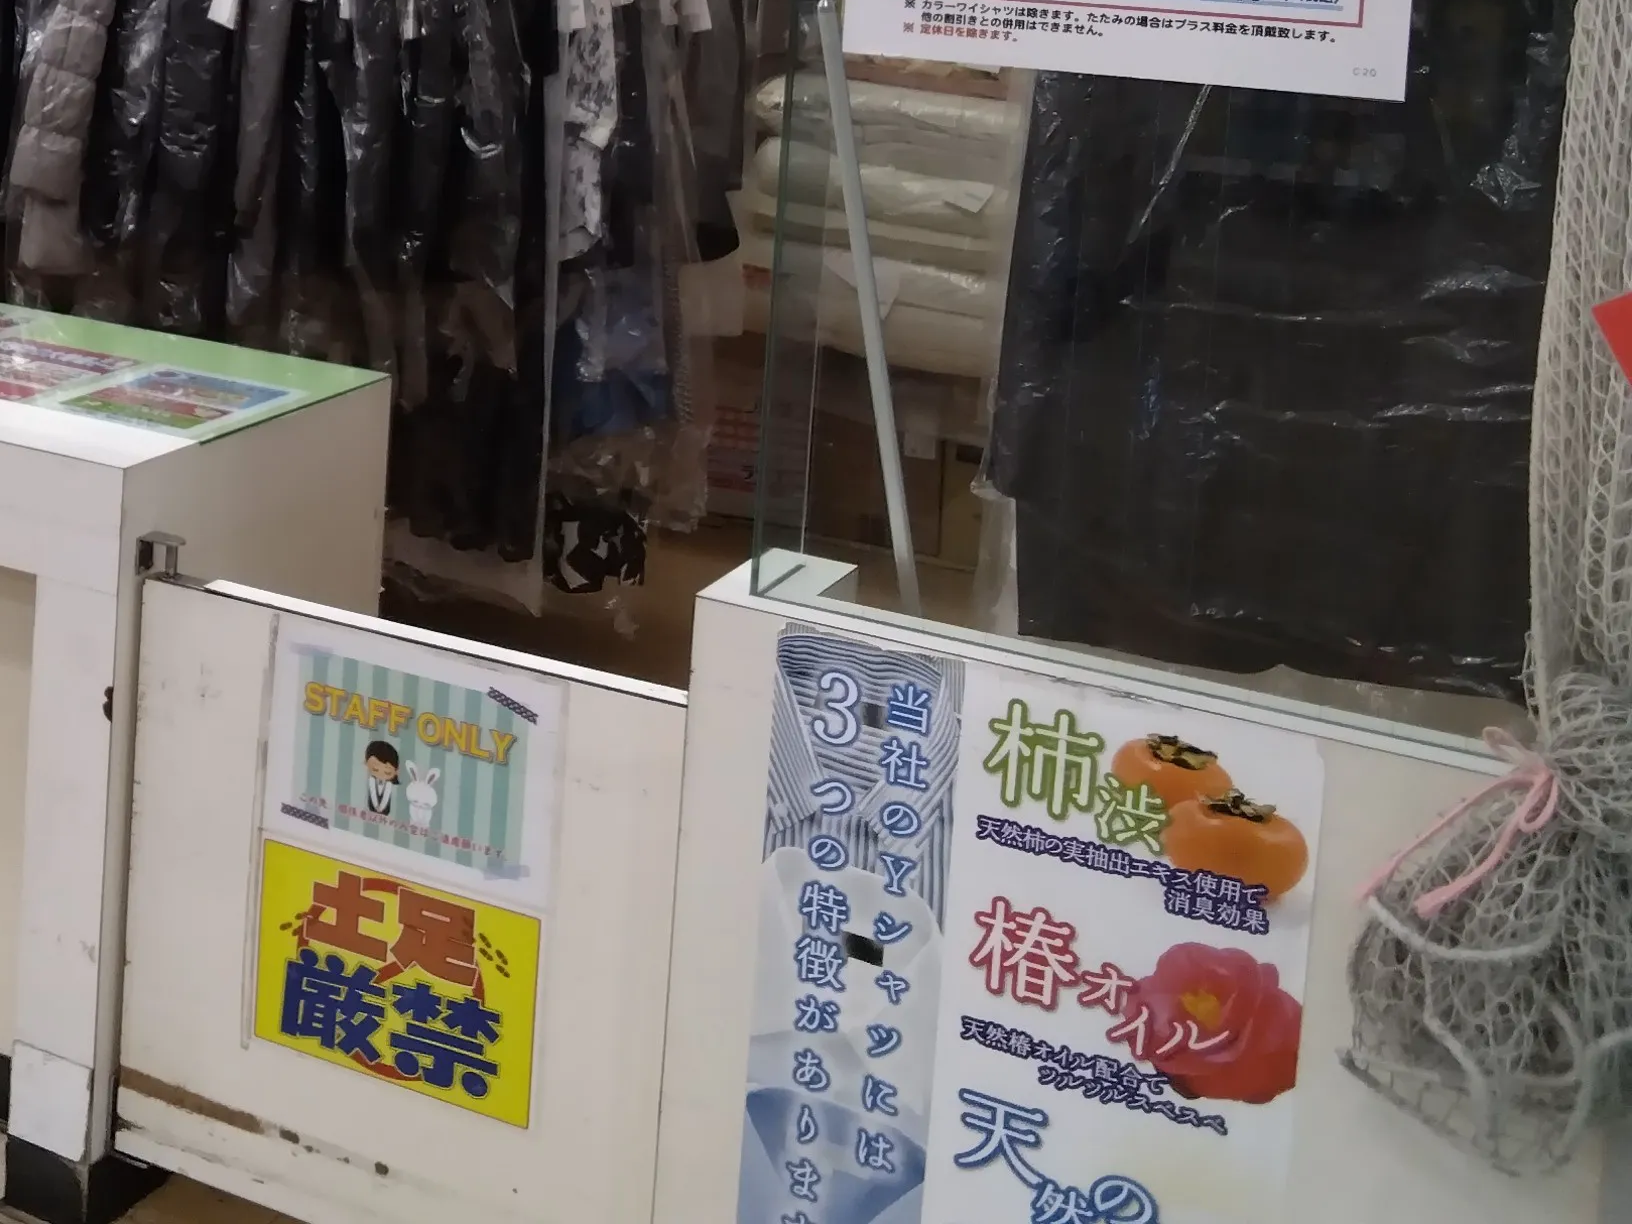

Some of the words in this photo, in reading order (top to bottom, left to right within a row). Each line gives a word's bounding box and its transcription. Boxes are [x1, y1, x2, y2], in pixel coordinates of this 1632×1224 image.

[302, 680, 412, 735] STAFF
[416, 711, 520, 766] ONLY
[982, 697, 1172, 856] 柿渋
[302, 870, 480, 989] 土足
[781, 671, 860, 1224] 3つの特徴がありま
[855, 682, 931, 1174] 当社のYシャツには
[970, 896, 1230, 1057] 椿オイル
[1165, 888, 1269, 935] 消臭効果
[280, 947, 503, 1099] 厳禁
